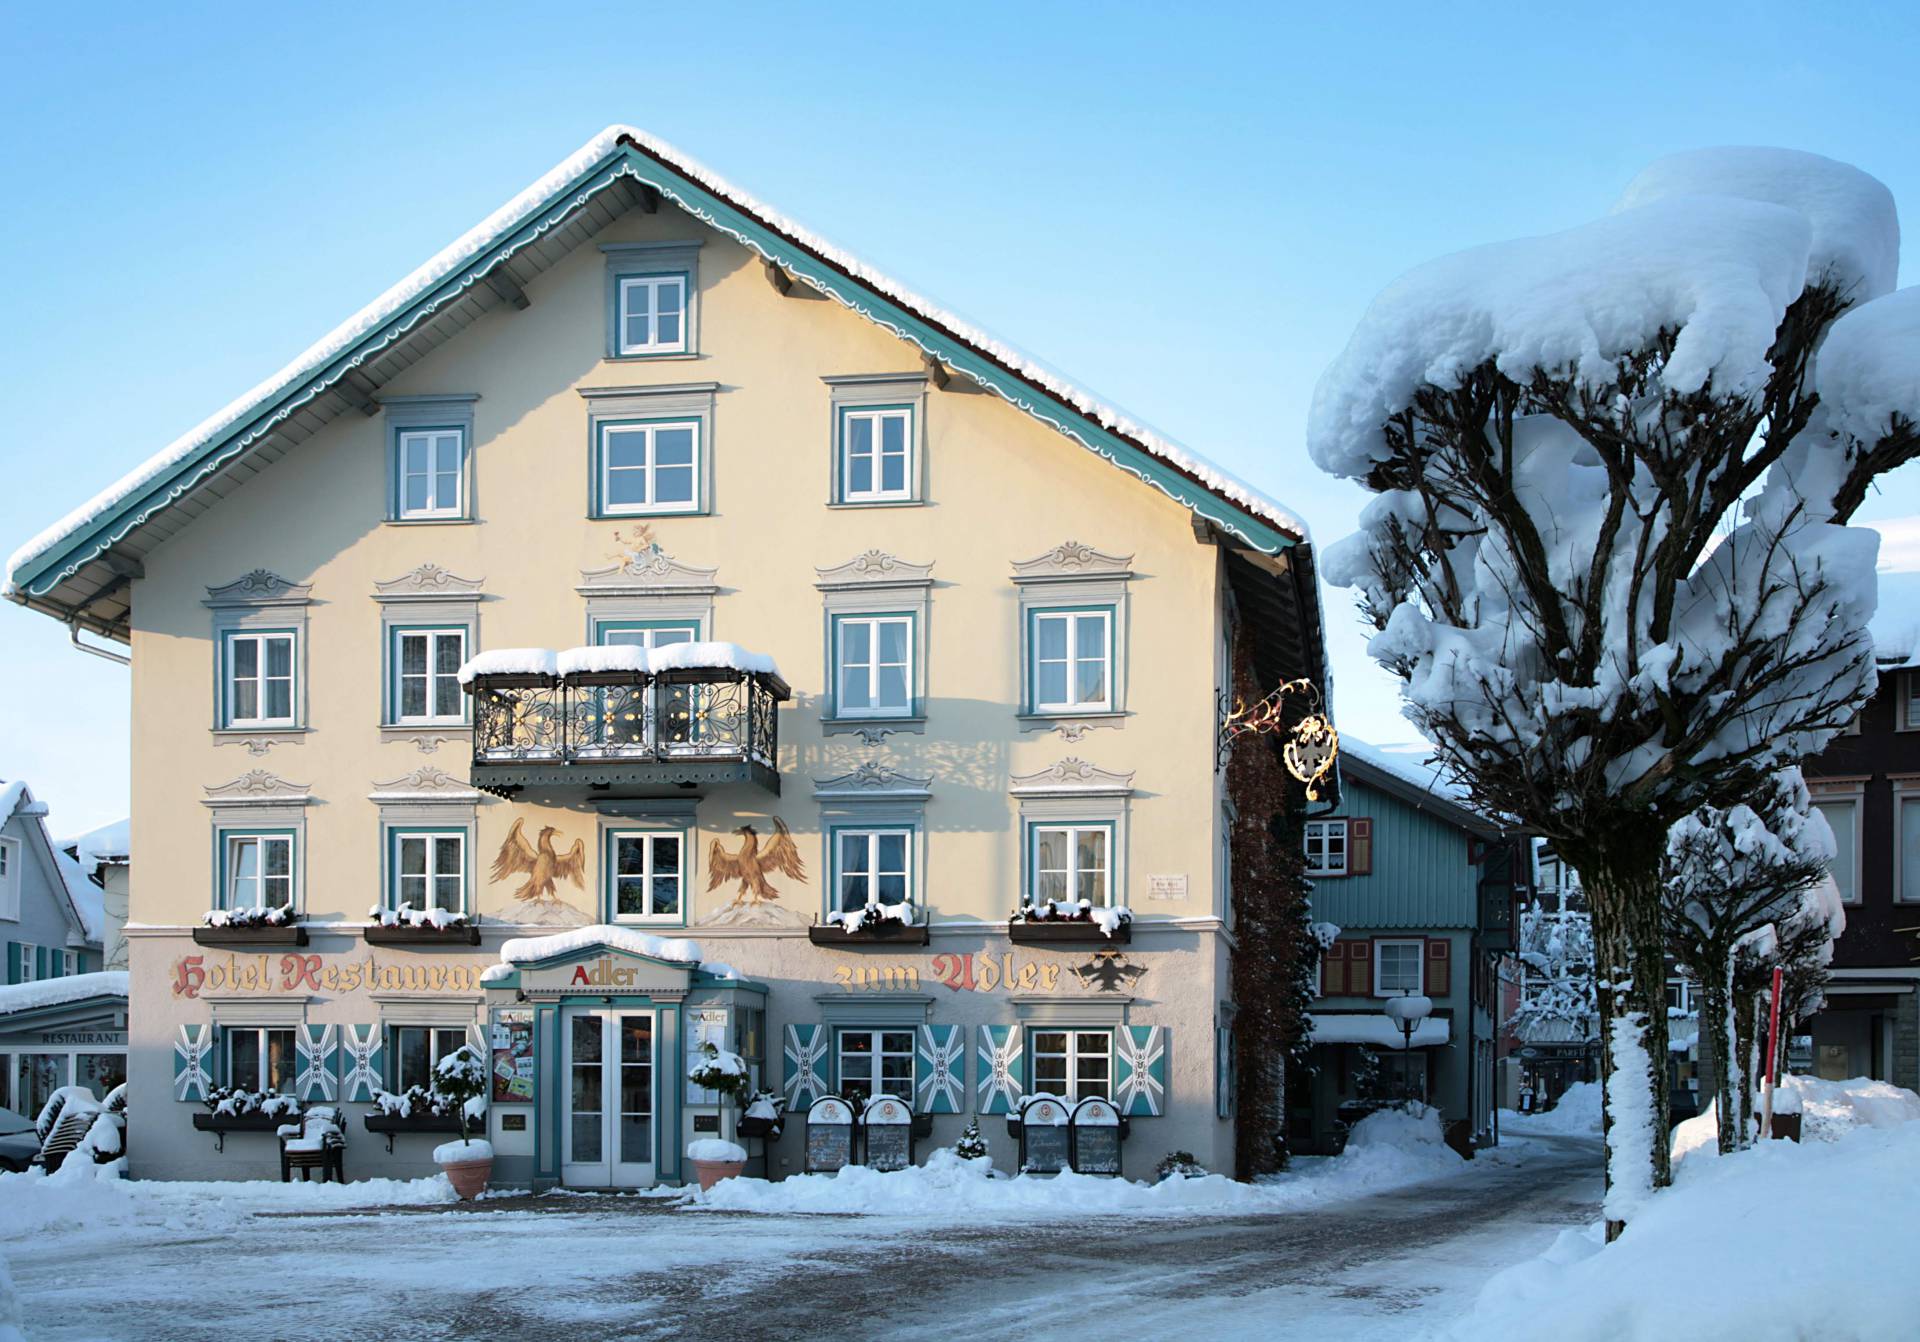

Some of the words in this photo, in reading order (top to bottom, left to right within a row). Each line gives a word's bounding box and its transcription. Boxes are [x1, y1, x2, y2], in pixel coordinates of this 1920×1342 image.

[172, 954, 272, 998] Hotel
[833, 964, 921, 993] zum
[931, 952, 1061, 992] Adler
[570, 959, 639, 986] Adler
[42, 1032, 120, 1044] RESTAURANT
